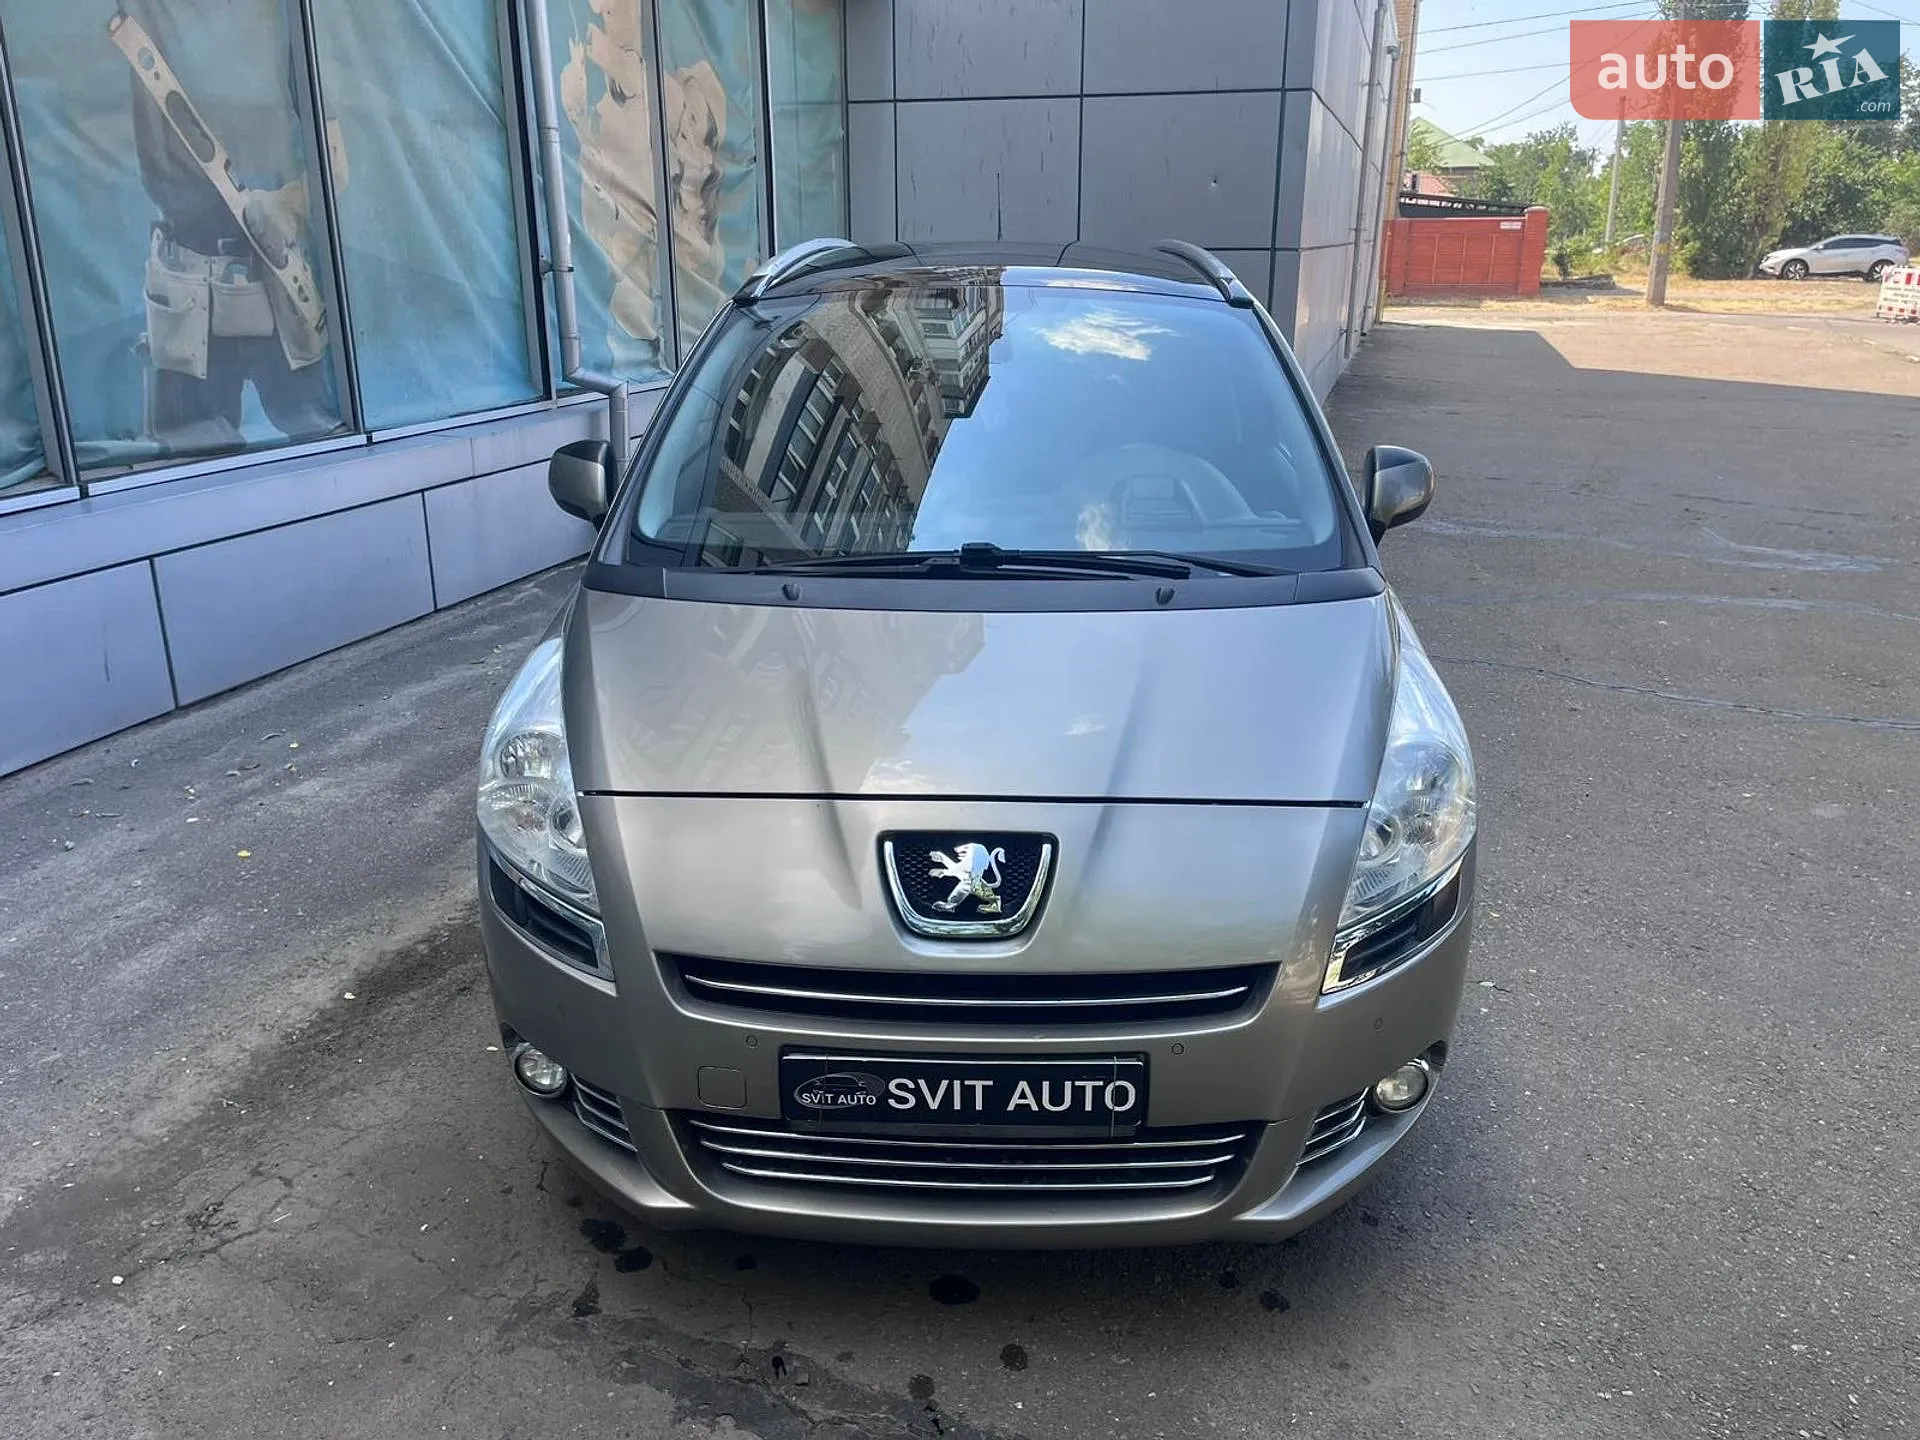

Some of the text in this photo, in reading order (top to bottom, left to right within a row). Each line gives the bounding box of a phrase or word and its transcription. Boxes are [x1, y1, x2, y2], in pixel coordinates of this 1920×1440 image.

[801, 1092, 876, 1106] SVIT AUTO
[887, 1078, 1136, 1112] SVIT AUTO
